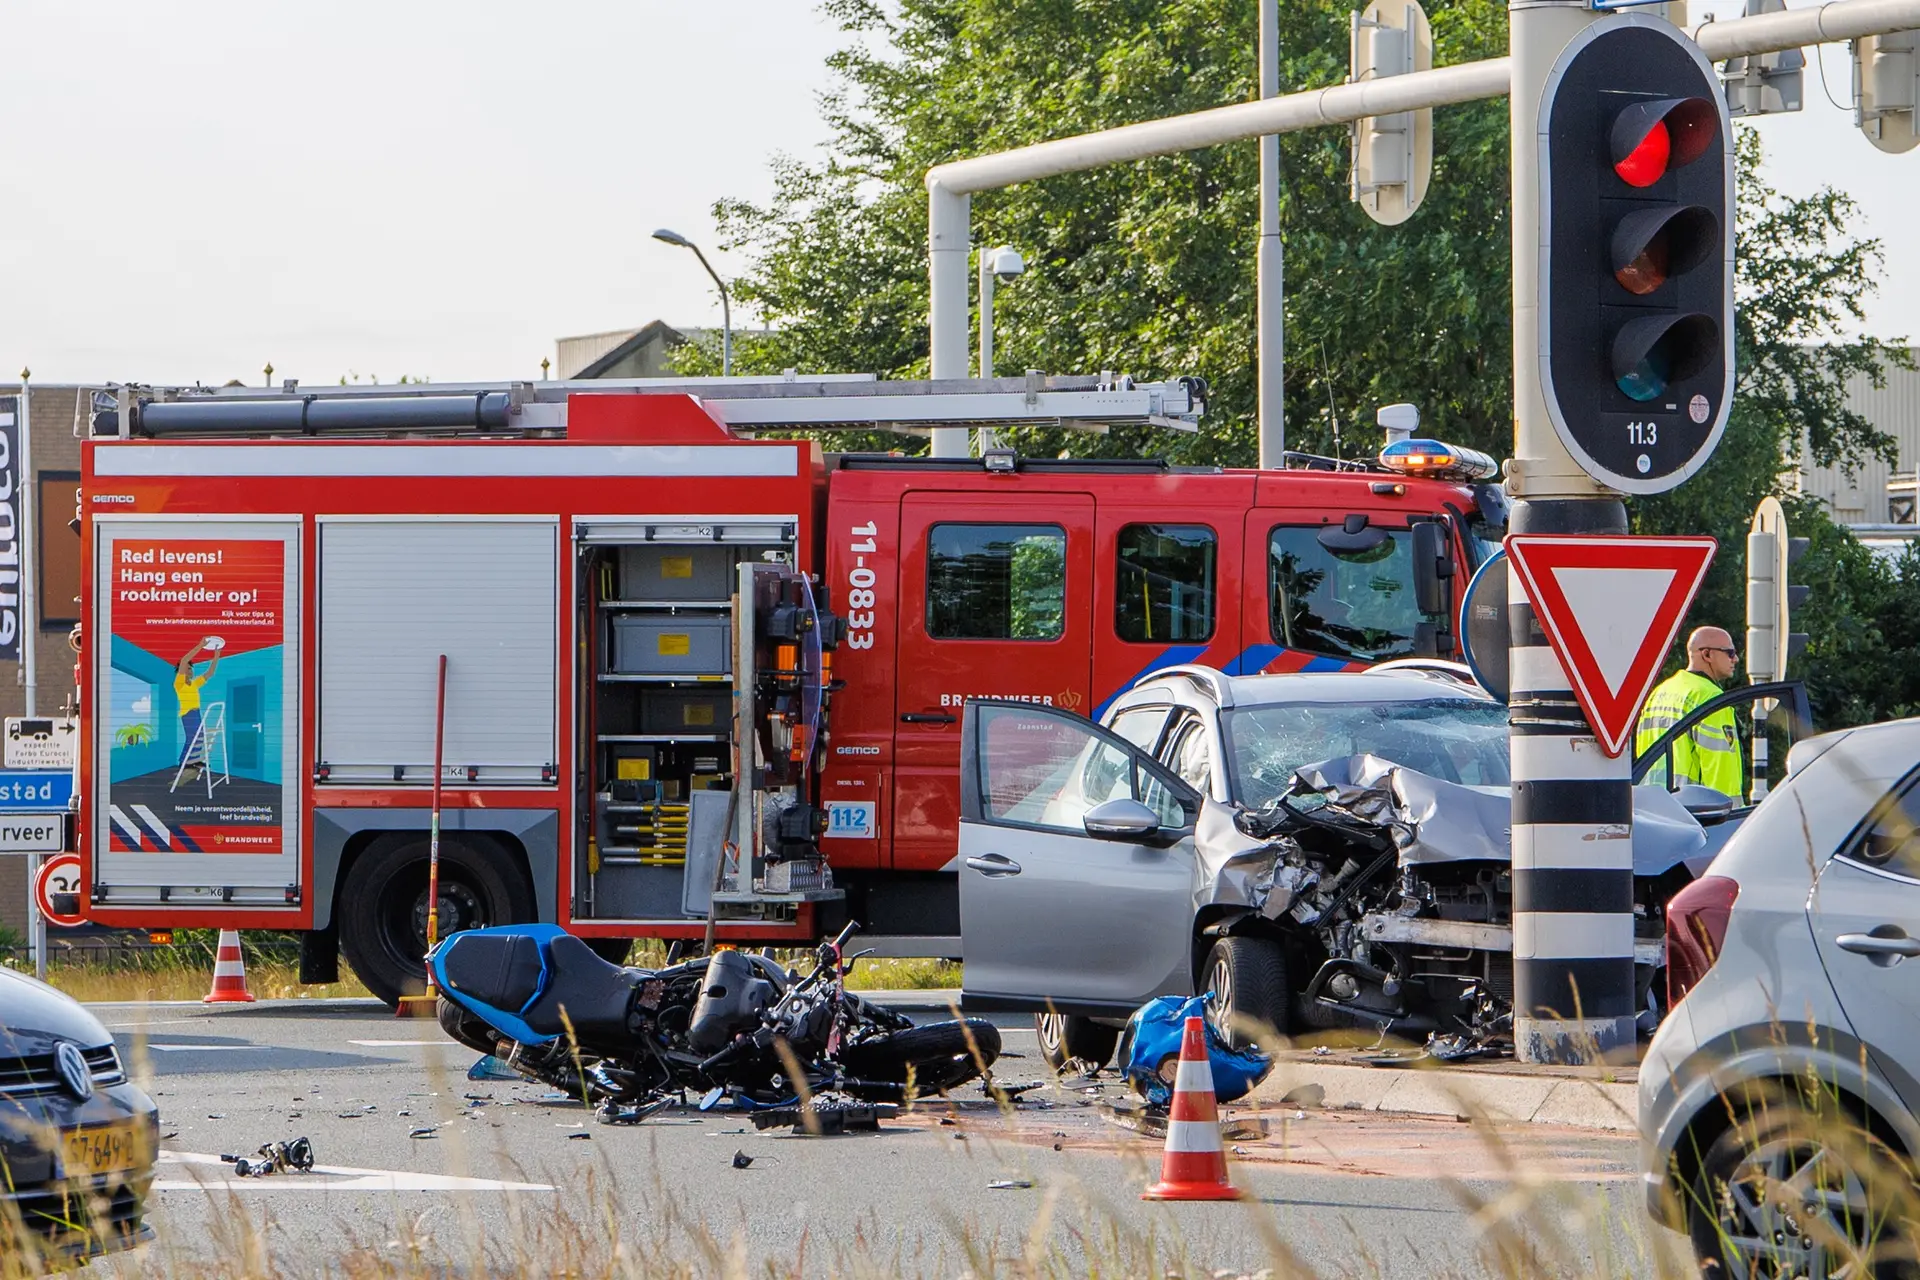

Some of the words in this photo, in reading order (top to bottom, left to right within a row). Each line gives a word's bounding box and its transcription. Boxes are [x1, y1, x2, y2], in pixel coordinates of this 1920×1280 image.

[1626, 421, 1657, 445] 11.3
[698, 527, 711, 535] K2
[121, 549, 154, 564] Red
[160, 549, 223, 564] levens!
[121, 568, 166, 586] Hang
[171, 571, 203, 583] een
[848, 520, 878, 650] 11-0833
[120, 587, 223, 602] rookmelder
[228, 588, 257, 605] op!
[221, 610, 234, 618] Kijk
[252, 610, 264, 619] tips
[836, 746, 880, 755] GEMCO
[450, 767, 462, 776] K4
[0, 781, 51, 801] stad
[194, 805, 201, 813] je
[2, 826, 54, 841] rveer
[225, 836, 273, 844] BRANDWEER
[210, 888, 223, 897] K6
